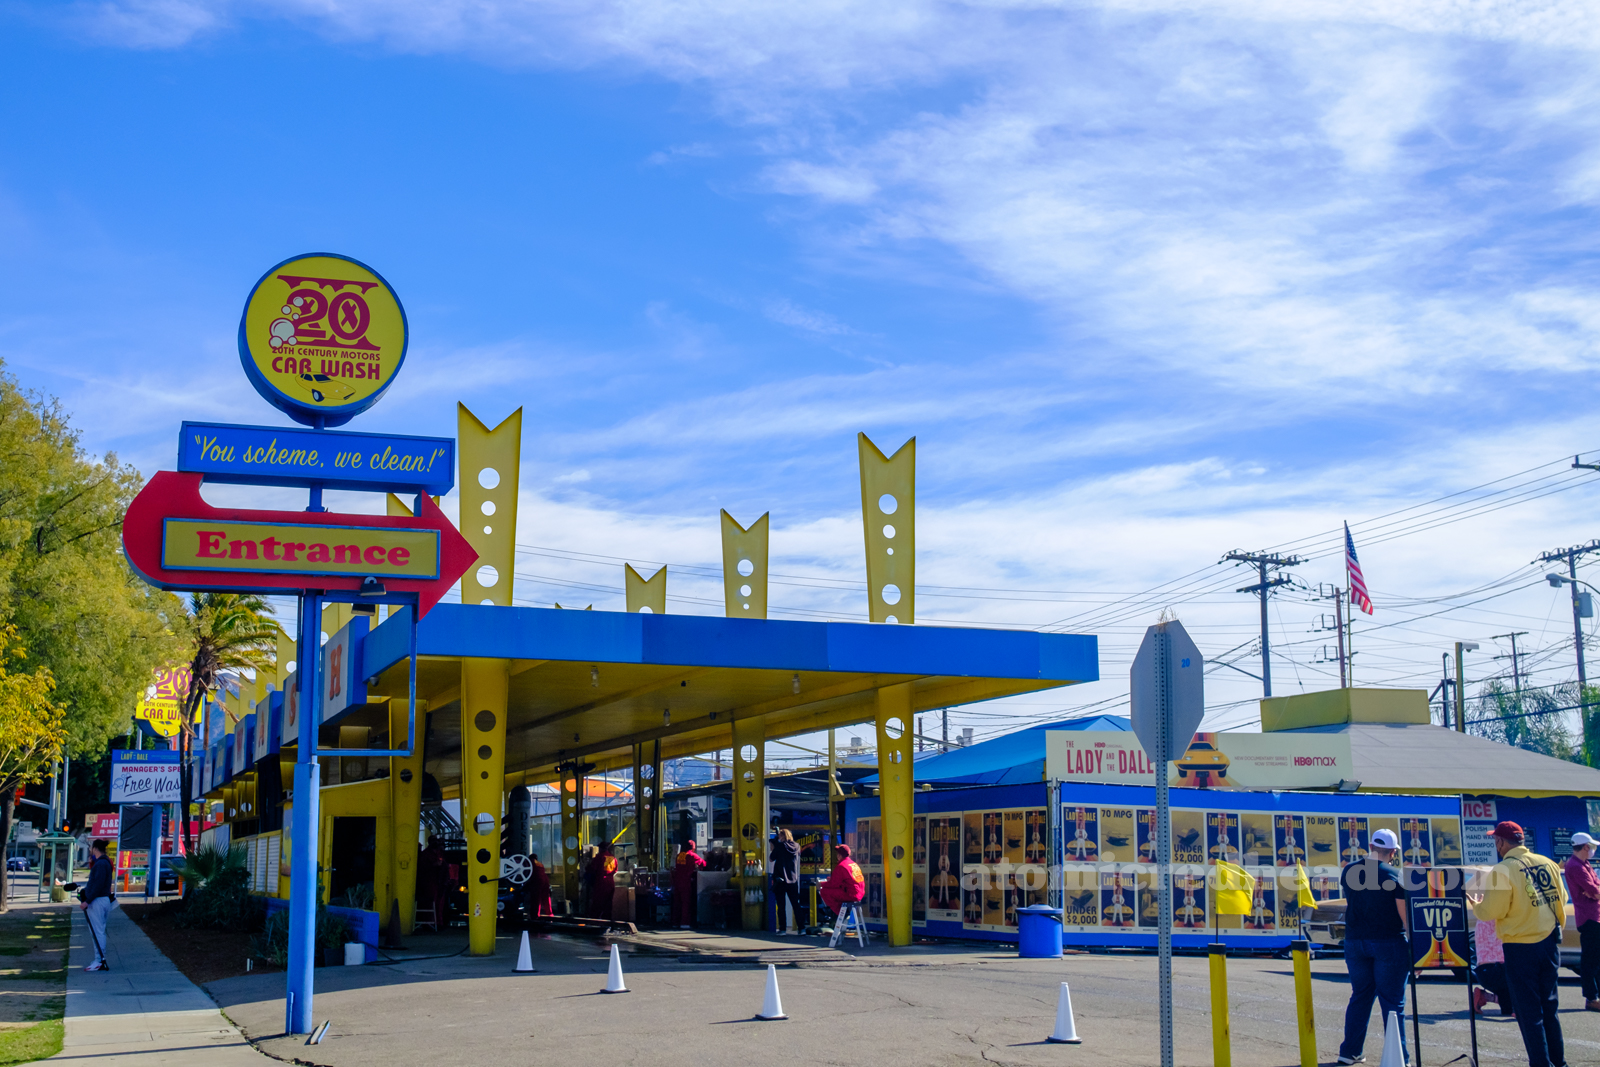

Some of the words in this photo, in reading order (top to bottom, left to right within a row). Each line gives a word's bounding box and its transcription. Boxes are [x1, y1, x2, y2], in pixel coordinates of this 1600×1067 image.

[272, 346, 295, 355] 20TH
[298, 348, 338, 358] CENTURY
[340, 350, 381, 361] MOTORS
[272, 356, 312, 374] CAR
[320, 360, 380, 380] WASH
[243, 438, 324, 469] scheme,
[334, 450, 363, 469] we
[195, 530, 411, 567] Entrance
[1181, 658, 1190, 668] 20
[329, 644, 342, 700] H
[143, 708, 164, 720] CAR
[1066, 740, 1074, 748] THE
[1106, 752, 1114, 760] AND
[1294, 756, 1336, 766] HBOmax
[1066, 750, 1103, 774] LADY
[1106, 764, 1115, 772] THE
[124, 775, 152, 794] Free
[154, 776, 181, 794] Was
[1101, 810, 1112, 818] 70
[1114, 810, 1132, 818] MPG
[1306, 816, 1316, 825] 70
[1318, 817, 1334, 826] MPG
[1174, 844, 1203, 853] UNDER
[1174, 853, 1204, 864] $2,000
[1066, 906, 1097, 915] UNDER
[1066, 914, 1098, 926] $2,000
[1423, 908, 1452, 928] VIP
